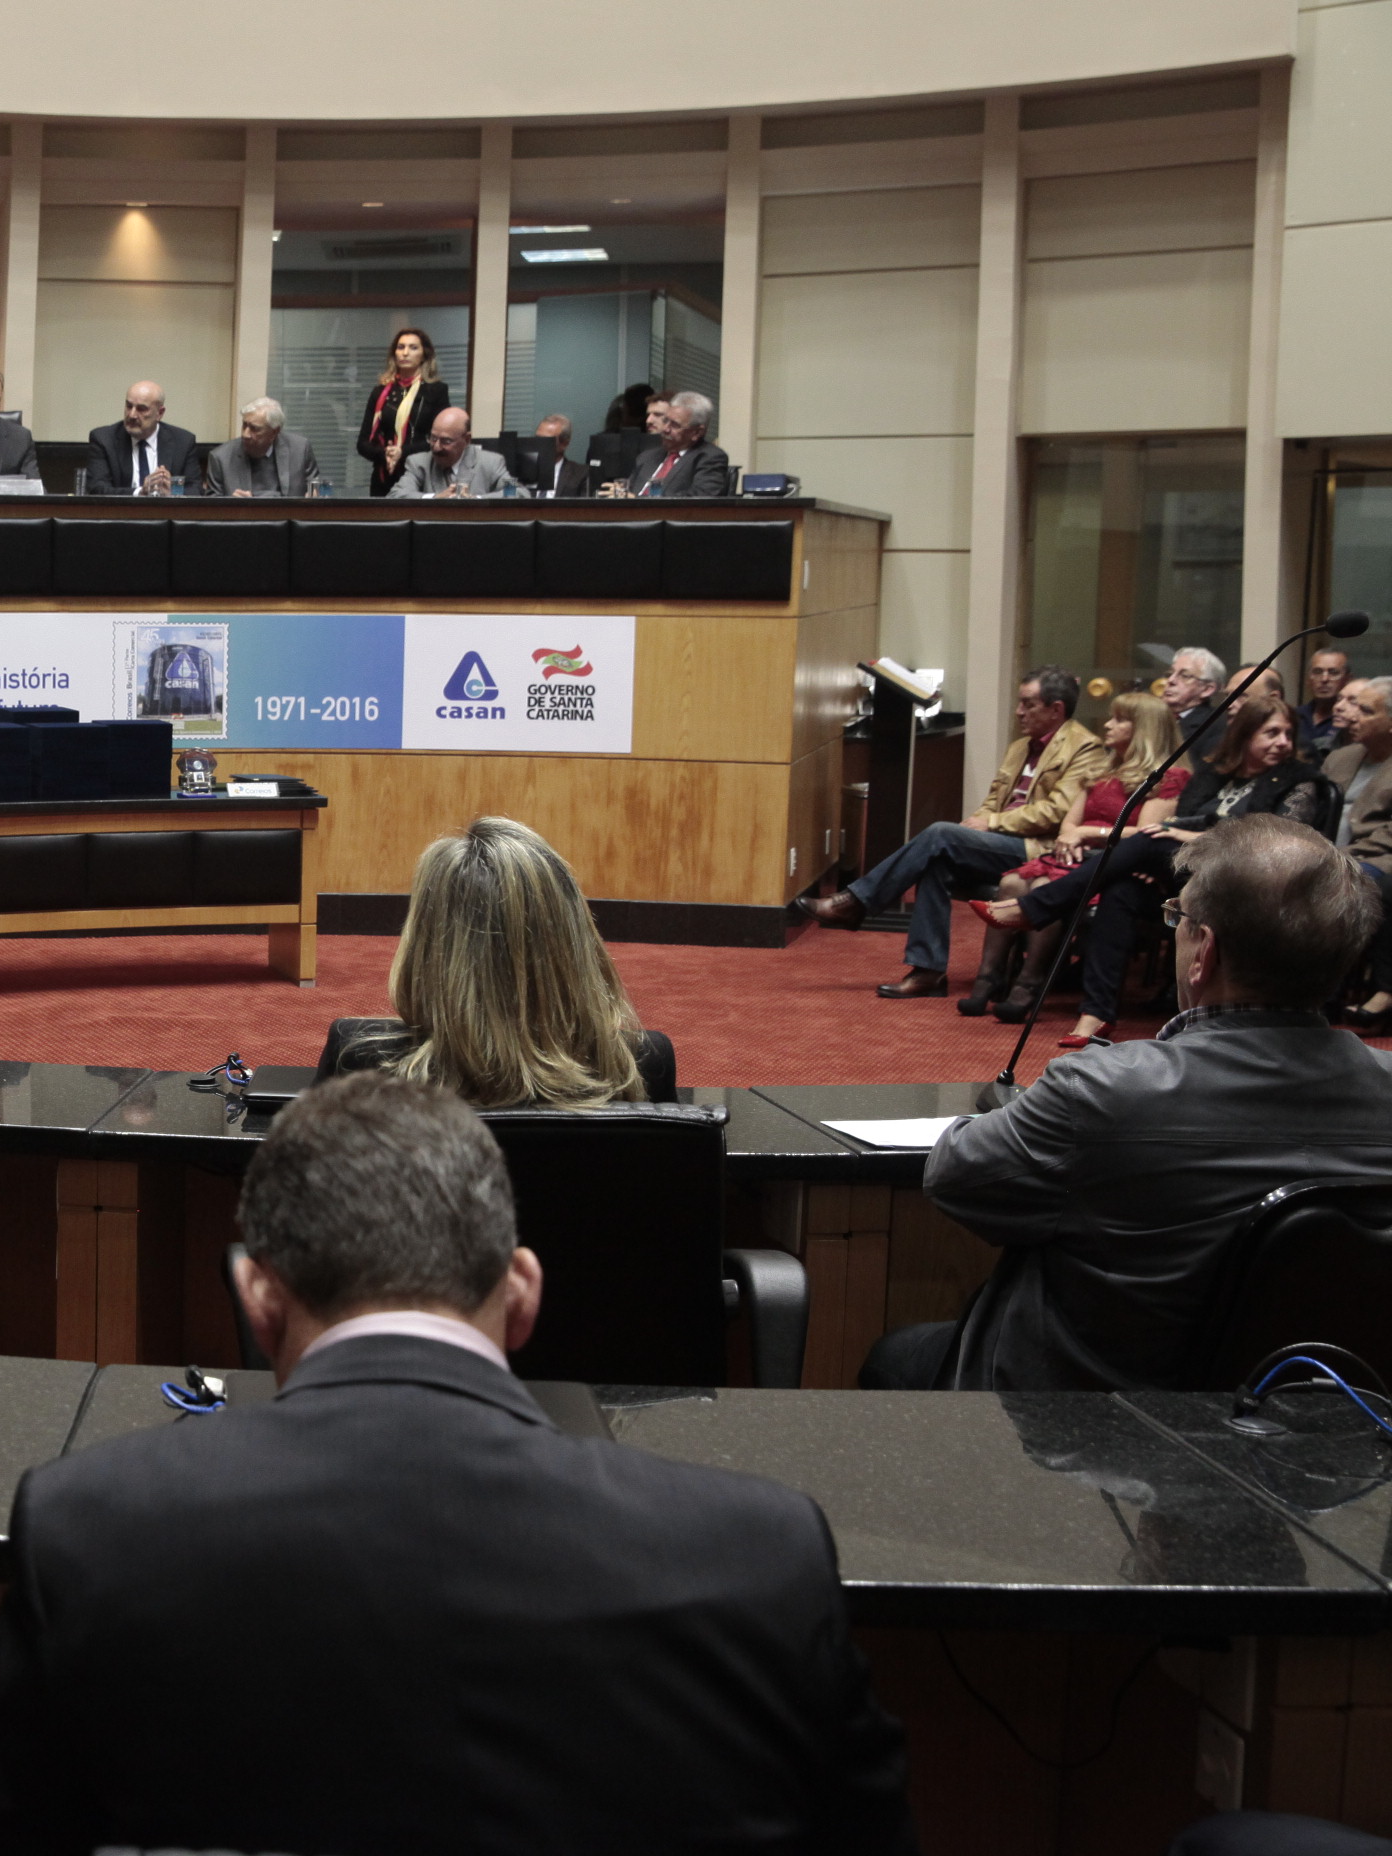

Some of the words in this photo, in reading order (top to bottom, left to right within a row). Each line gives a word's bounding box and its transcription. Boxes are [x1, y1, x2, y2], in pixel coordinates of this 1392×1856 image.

[527, 684, 596, 696] GOVERNO
[254, 696, 379, 721] 1971-2016
[527, 697, 546, 708] DE
[549, 697, 594, 708] SANTA
[435, 705, 506, 720] casan
[526, 709, 595, 721] CATARINA
